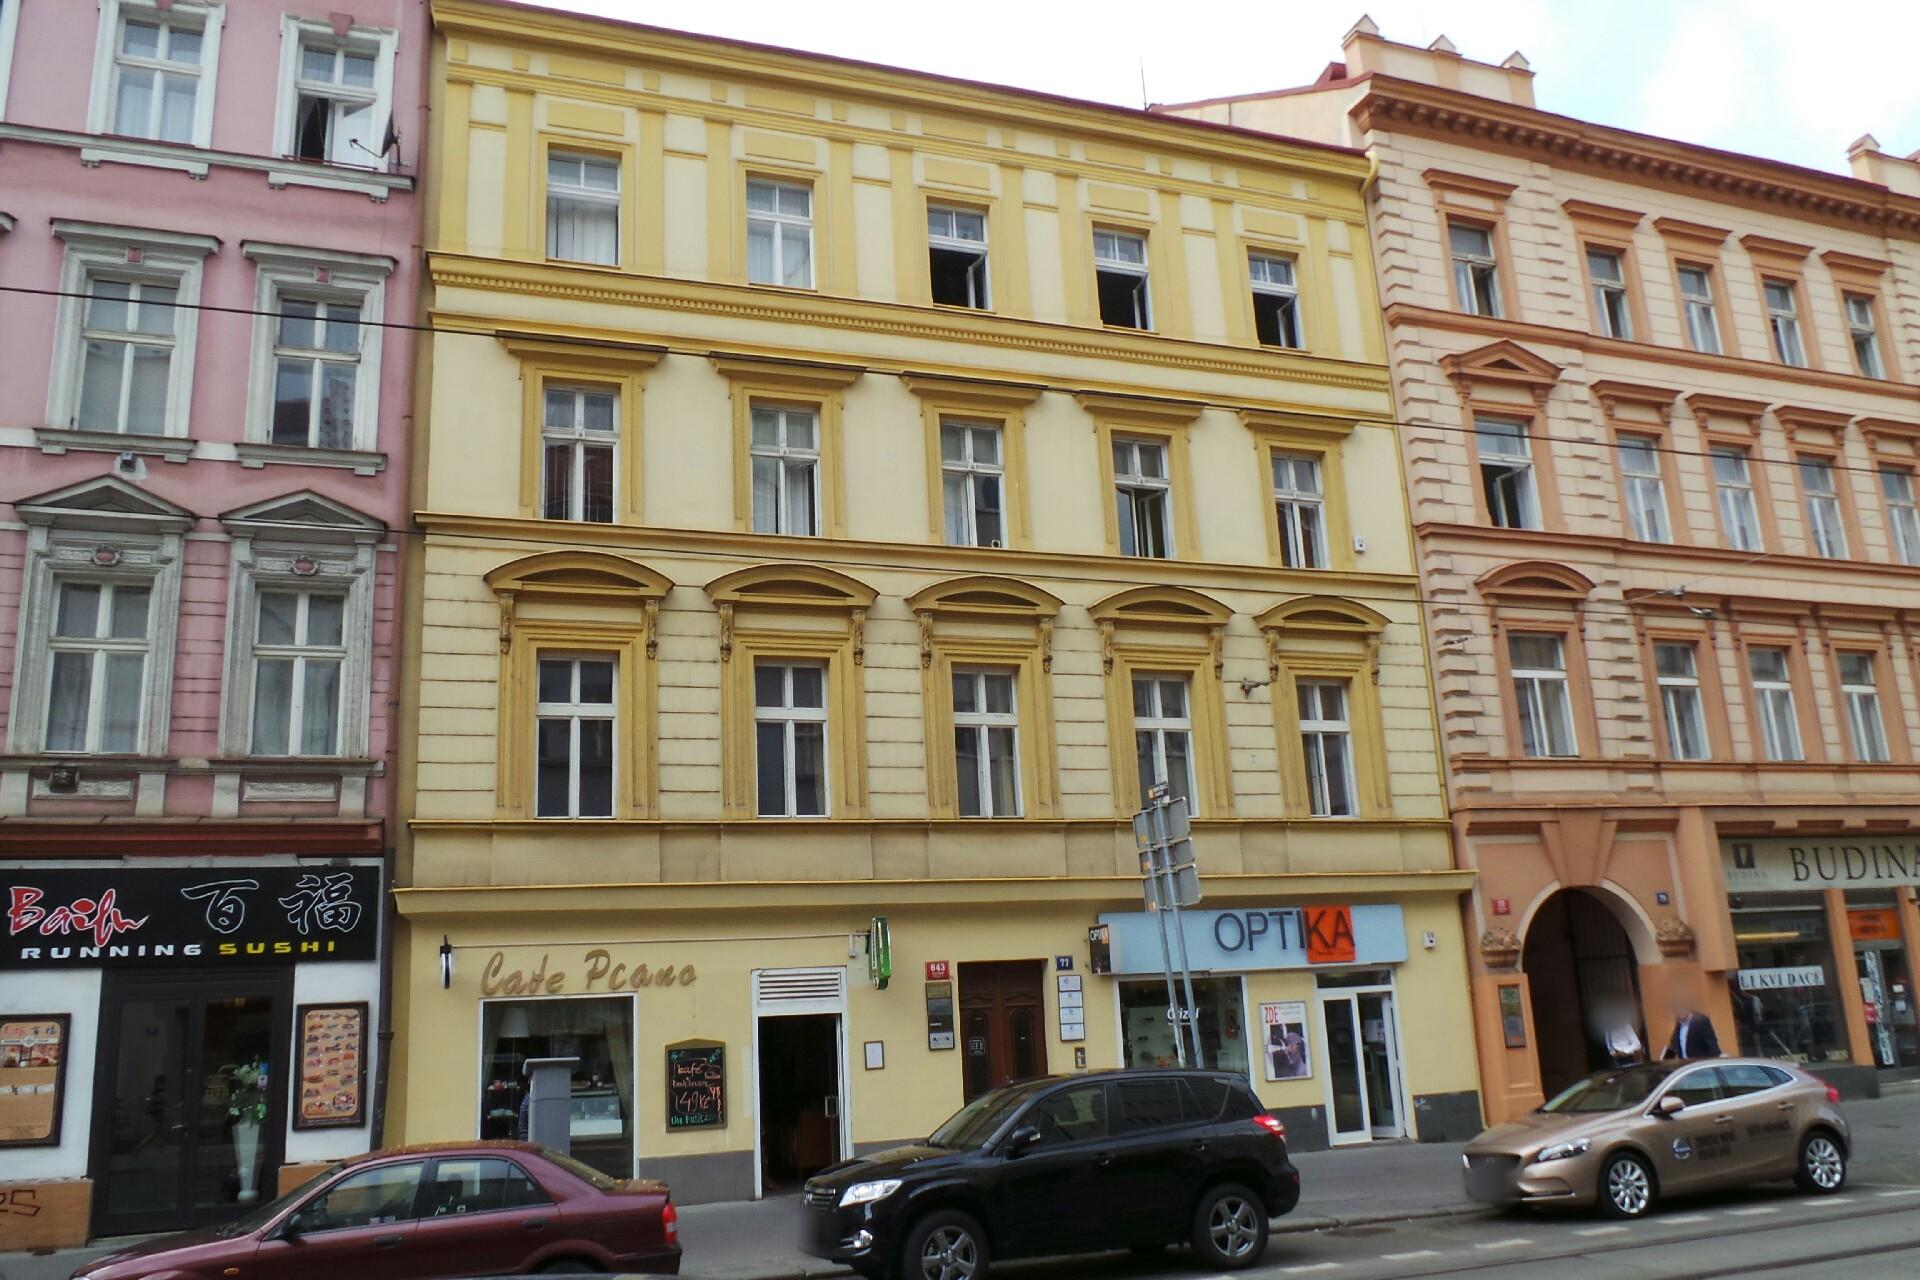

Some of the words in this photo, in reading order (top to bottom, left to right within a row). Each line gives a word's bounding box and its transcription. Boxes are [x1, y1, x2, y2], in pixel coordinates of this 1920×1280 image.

[1214, 909, 1356, 952] OPTIKA
[21, 944, 201, 959] RUNNING
[219, 940, 335, 955] SUSHI
[930, 962, 946, 972] 643
[1060, 958, 1070, 967] 77
[1265, 1006, 1278, 1023] ZDE
